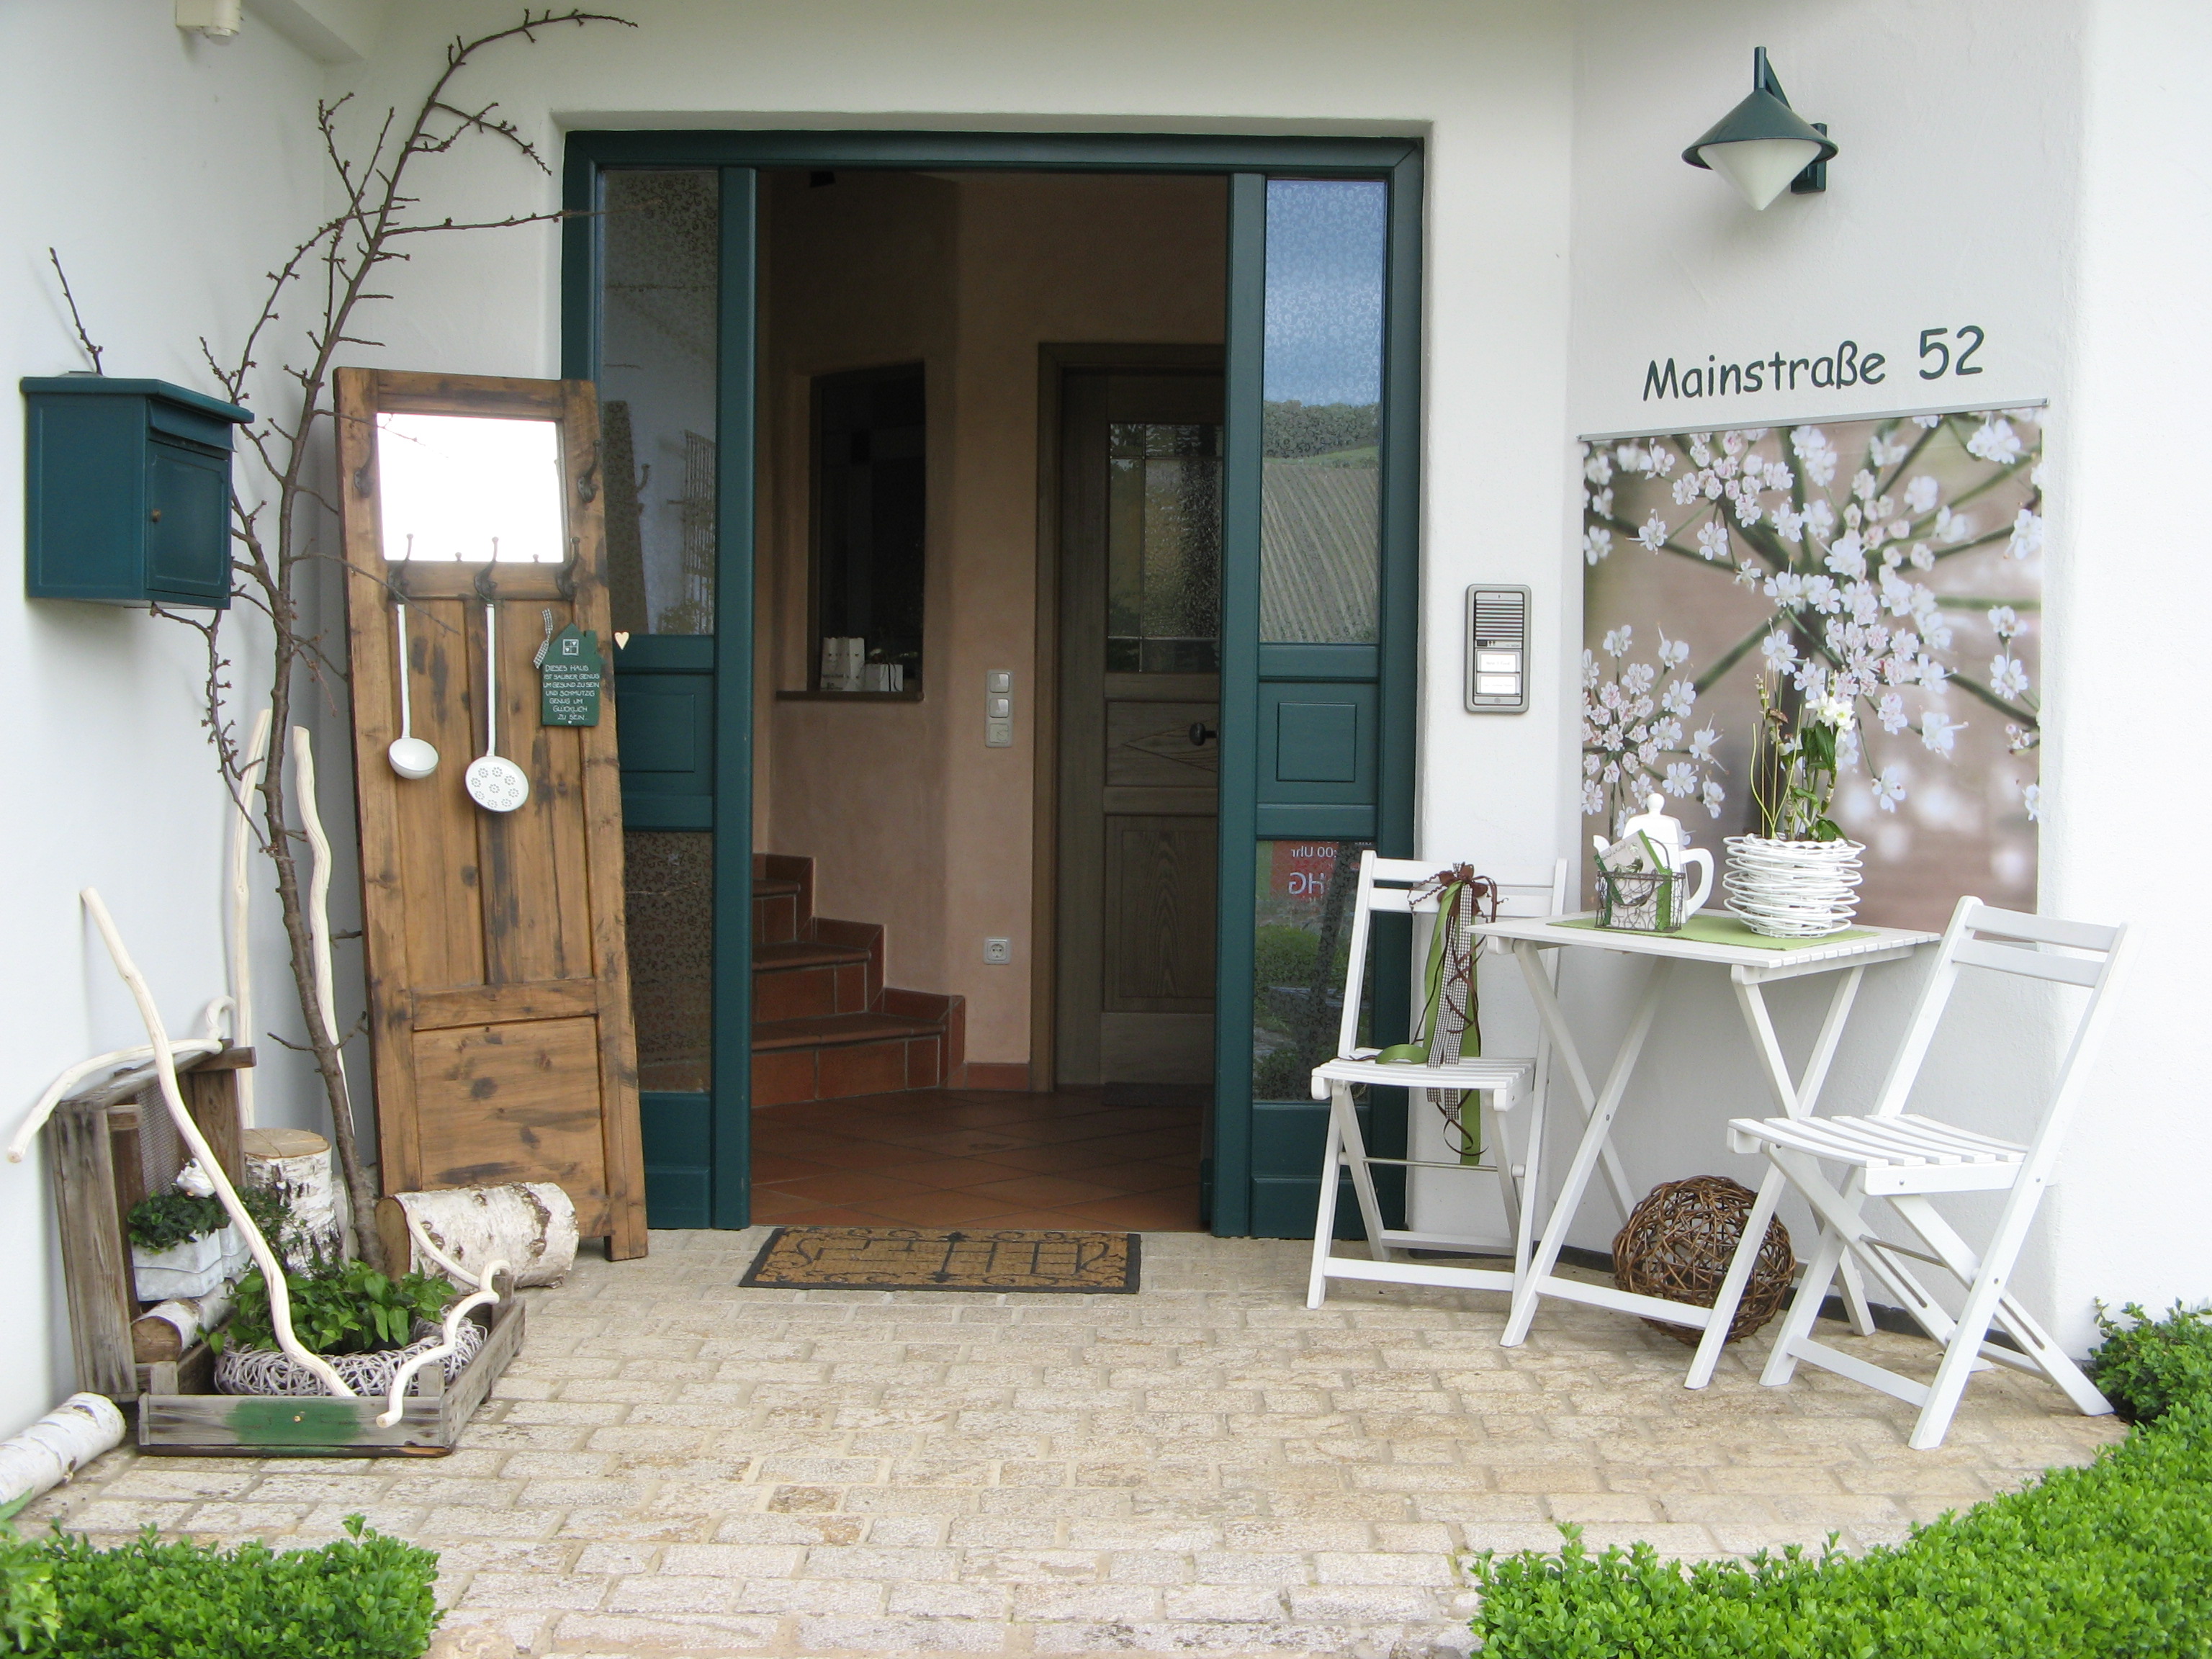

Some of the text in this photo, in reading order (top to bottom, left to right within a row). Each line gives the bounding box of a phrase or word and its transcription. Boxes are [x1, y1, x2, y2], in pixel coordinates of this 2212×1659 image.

[1642, 325, 1985, 402] Mainstraße 52
[552, 705, 588, 714] GLÜCKLICH
